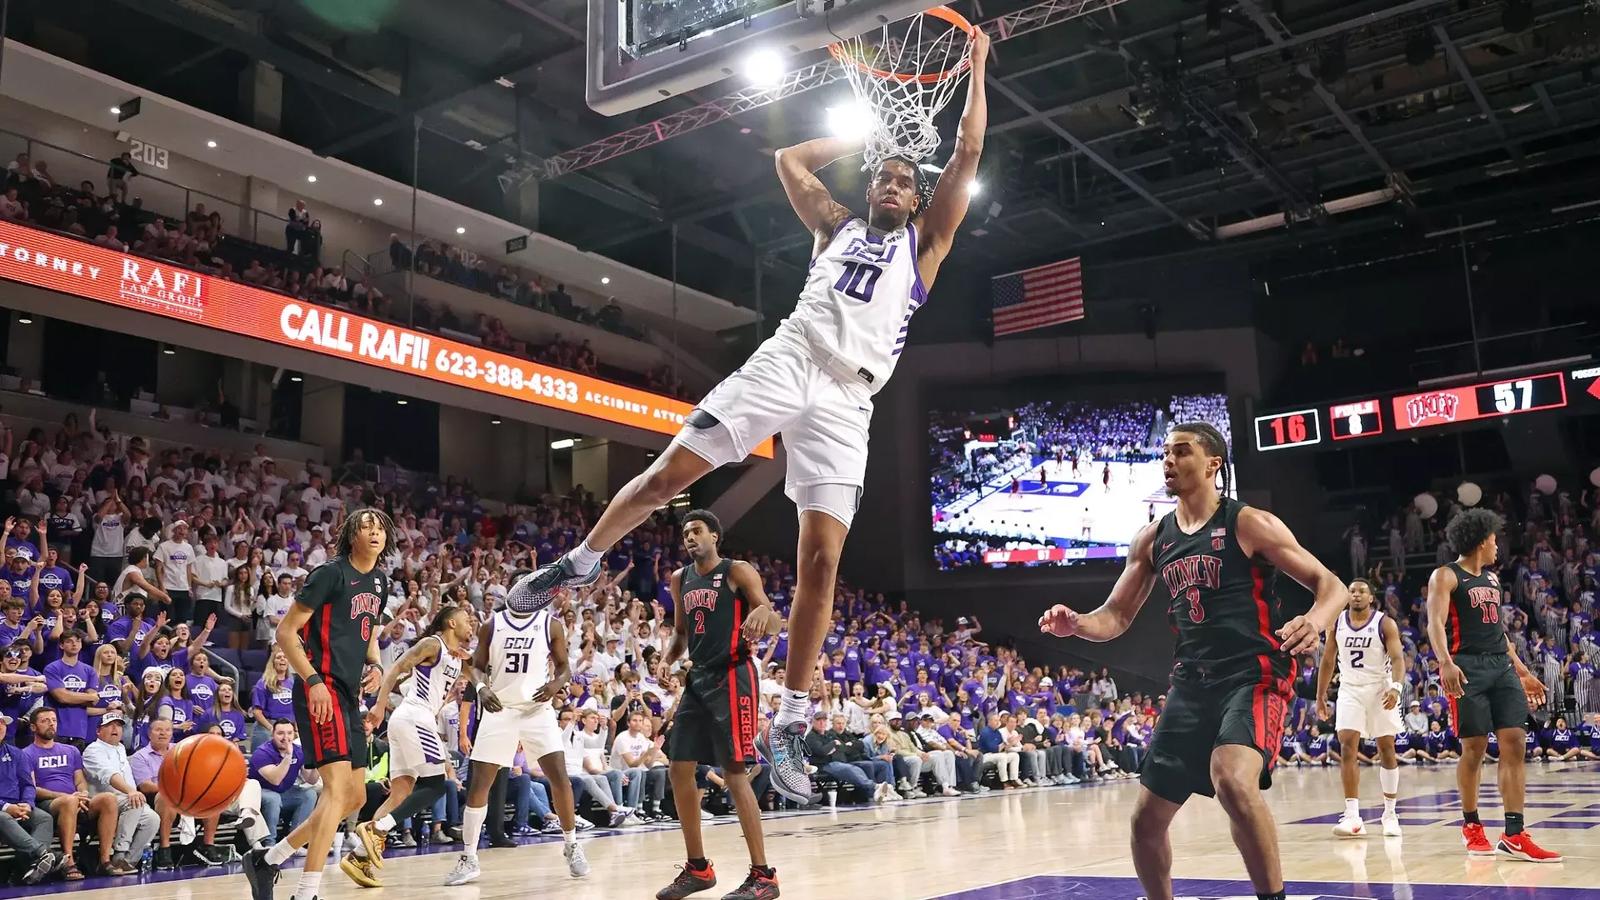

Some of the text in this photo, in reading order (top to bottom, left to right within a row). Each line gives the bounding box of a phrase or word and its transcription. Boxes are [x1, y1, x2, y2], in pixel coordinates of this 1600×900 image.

[130, 140, 168, 169] 203
[121, 258, 202, 296] RAFI
[833, 260, 883, 303] 10
[120, 280, 203, 308] LAW GROUP
[280, 303, 578, 404] CALL RAFI! 623-388-4333
[585, 391, 688, 425] ACCIDENT ATTO
[1407, 393, 1459, 427] UNLV
[1493, 379, 1533, 413] 57
[1270, 414, 1307, 445] 16
[1162, 554, 1223, 599] UNLV
[350, 592, 382, 620] UNLV
[683, 588, 719, 615] UNLV
[1186, 586, 1206, 624] 3
[1479, 602, 1499, 624] 10
[361, 616, 371, 642] 6
[694, 610, 706, 634] 2
[503, 637, 535, 650] GCU
[1344, 636, 1373, 648] GCU
[505, 652, 530, 674] 31
[1350, 651, 1365, 669] 2
[739, 695, 755, 757] REBELS
[38, 754, 69, 769] GCU
